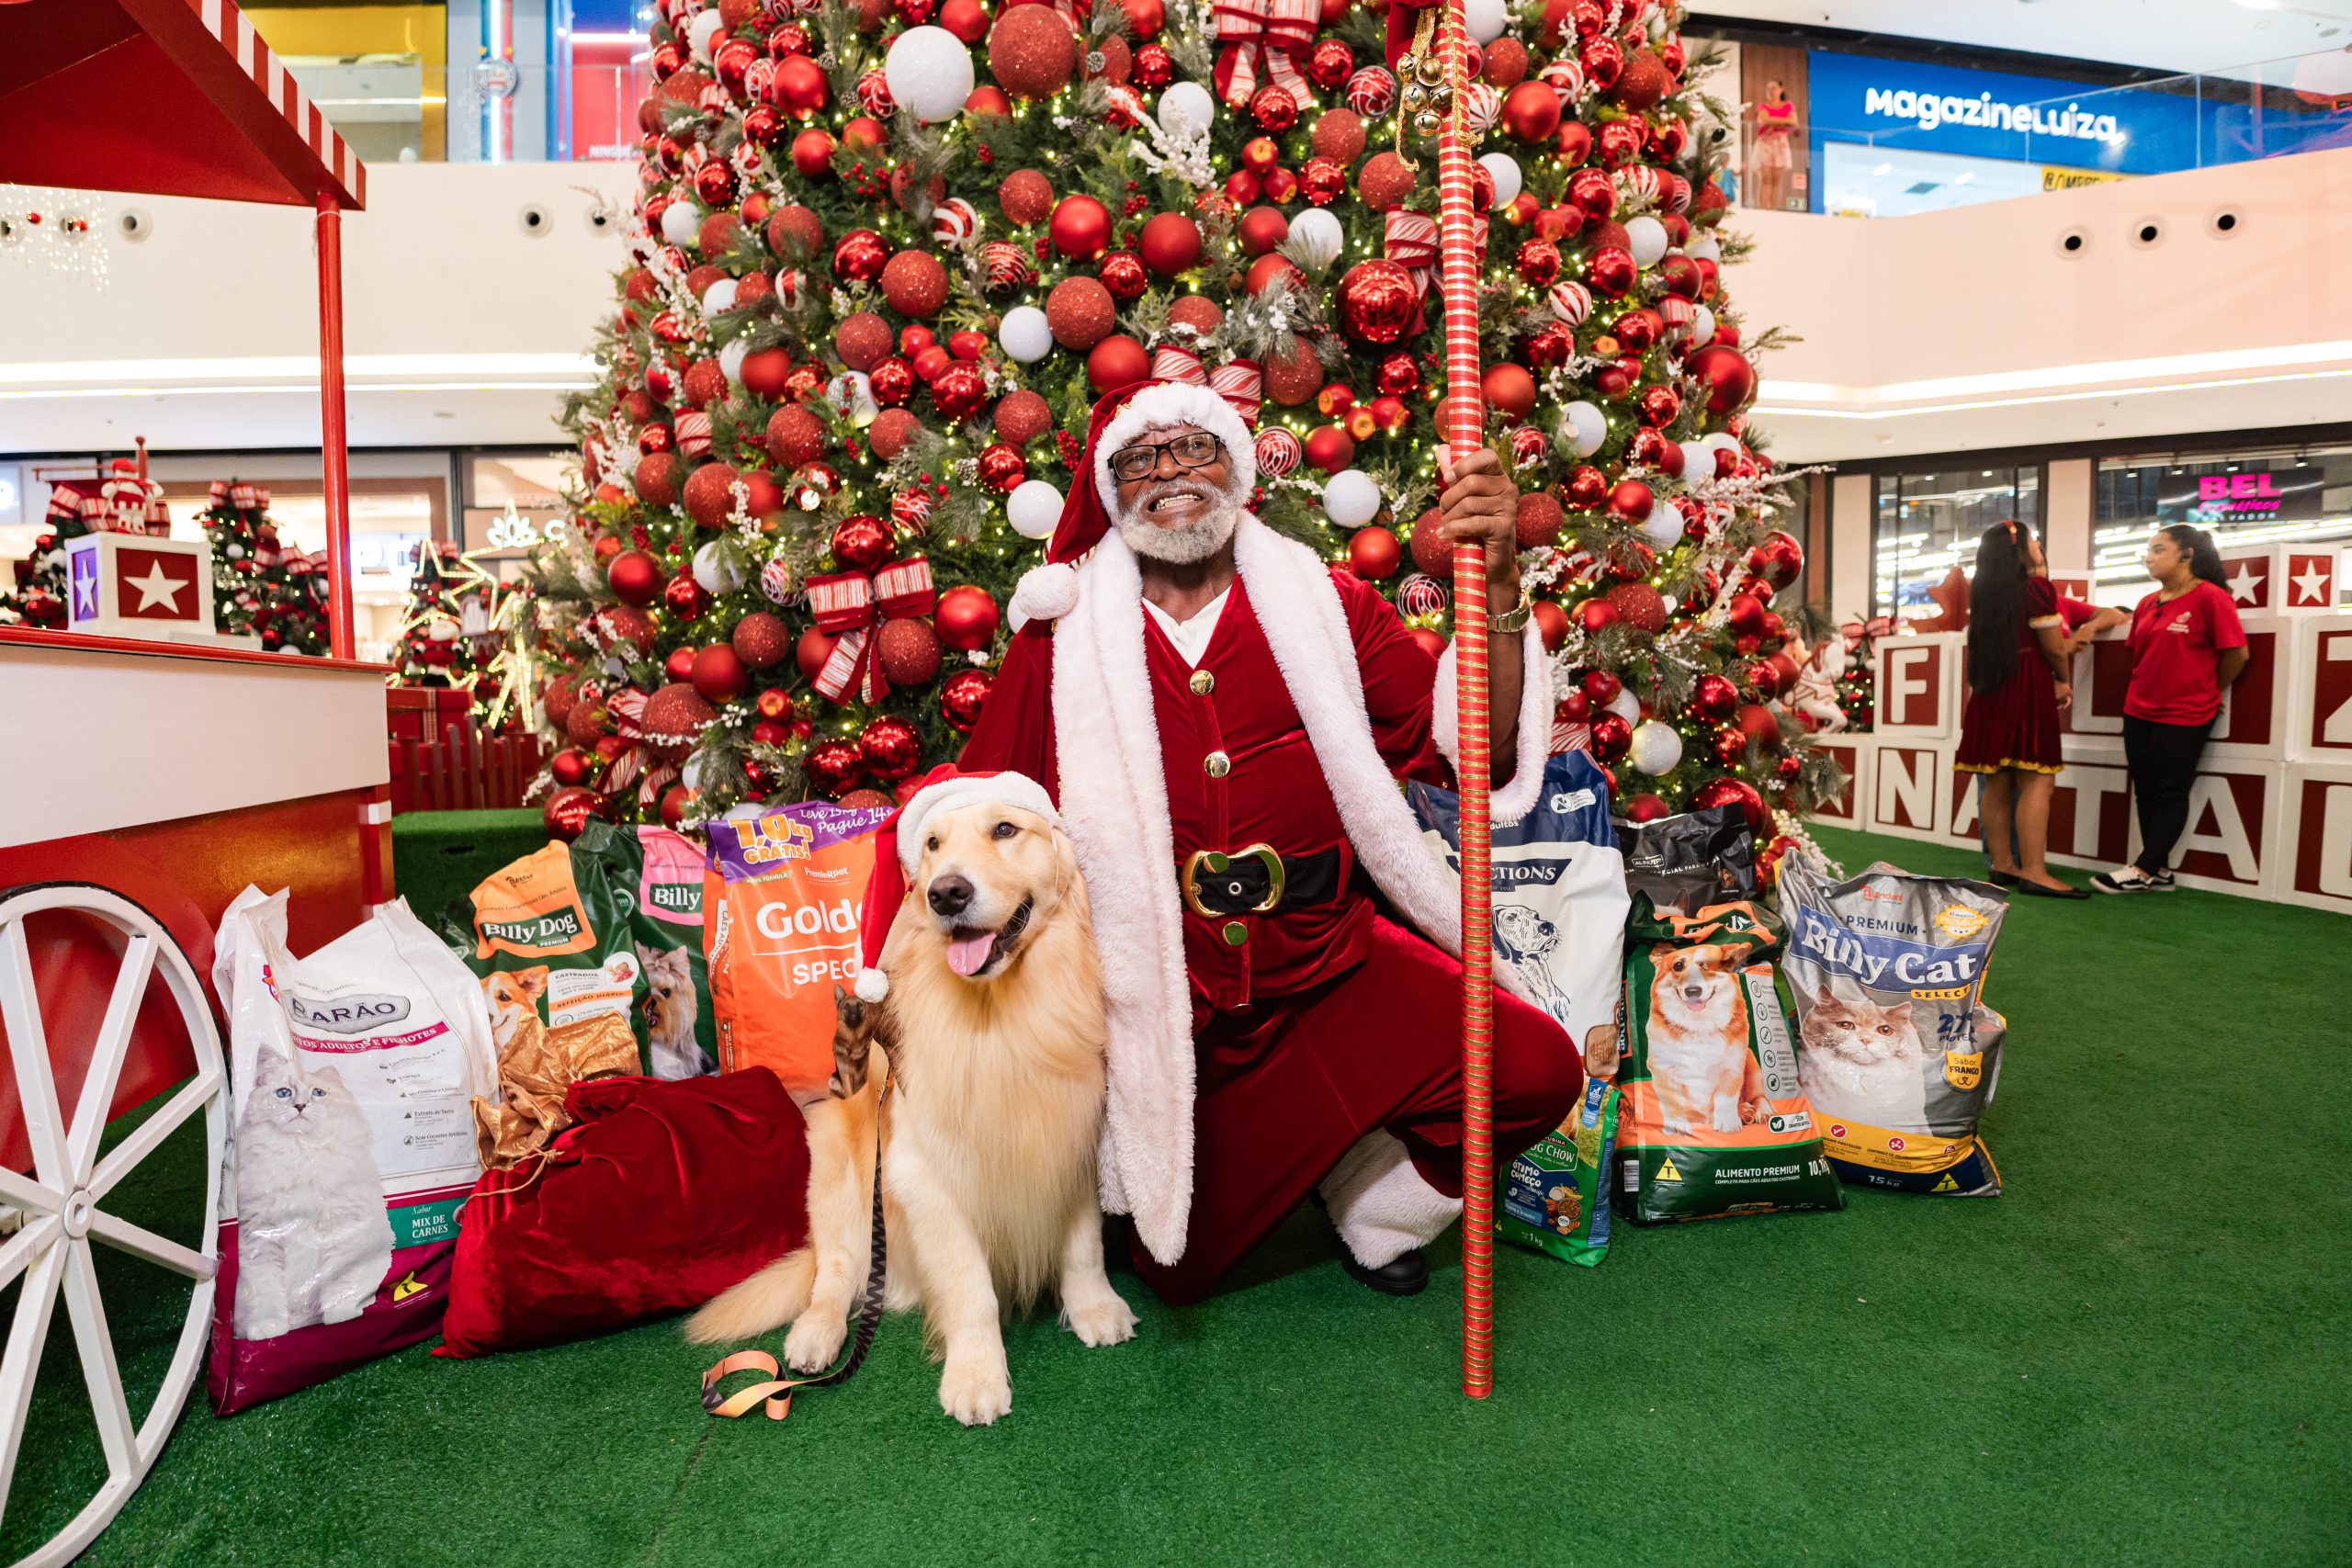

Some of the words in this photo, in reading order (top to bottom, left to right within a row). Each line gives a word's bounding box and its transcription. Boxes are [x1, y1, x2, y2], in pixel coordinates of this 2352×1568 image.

[2199, 472, 2282, 501] BEL
[817, 817, 867, 834] Pague
[743, 840, 812, 865] GRÁTIS!
[654, 886, 702, 910] Billy
[484, 922, 537, 943] Billy
[538, 913, 578, 937] Dog
[1847, 915, 1918, 936] PREMIUM
[539, 936, 569, 947] PREMIUM
[1894, 952, 1977, 985] Cat
[1915, 986, 1969, 998] SELECT
[292, 997, 396, 1023] BARÃO
[320, 1038, 371, 1050] ADULTOS
[372, 1038, 379, 1047] E
[381, 1028, 437, 1045] FILHOTES
[1954, 1057, 1976, 1066] Sabor
[1949, 1066, 1979, 1076] FRANGO
[1545, 1145, 1575, 1163] CHOW
[1512, 1159, 1540, 1177] ÓTIMO
[1715, 1168, 1761, 1178] ALIMENTO
[1763, 1165, 1800, 1176] PREMIUM
[1510, 1169, 1542, 1188] COMEÇO
[1869, 1175, 1884, 1184] 15
[411, 1205, 433, 1215] Sabor
[412, 1216, 431, 1229] MIX
[433, 1214, 446, 1224] DE
[412, 1224, 448, 1238] CARNES
[1529, 1233, 1533, 1241] 1
[1534, 1236, 1543, 1247] kg
